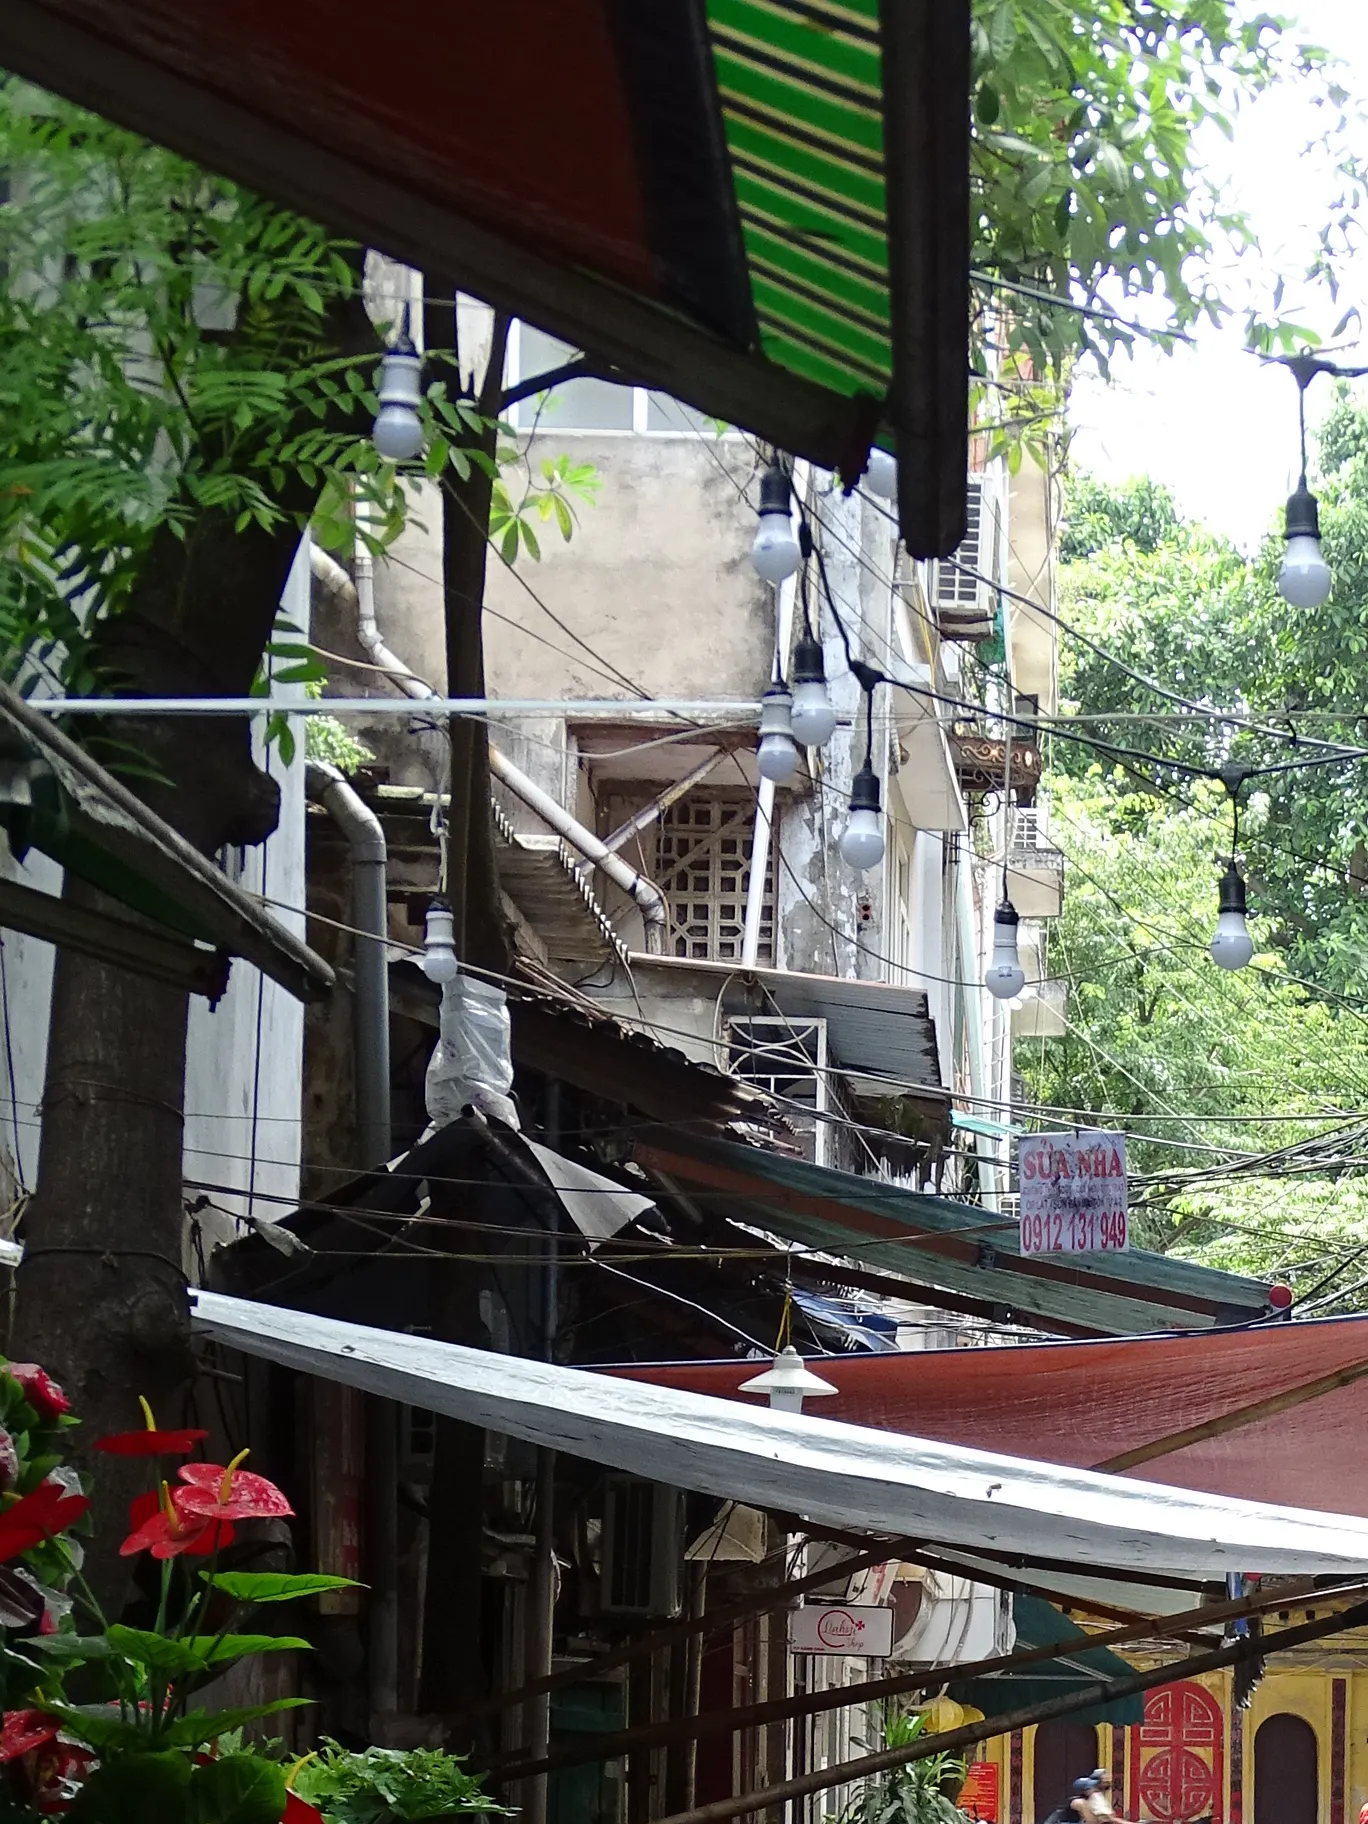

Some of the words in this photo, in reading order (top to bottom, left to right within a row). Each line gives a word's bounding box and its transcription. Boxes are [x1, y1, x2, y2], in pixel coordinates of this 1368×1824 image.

[1022, 1213, 1063, 1252] 0912
[1068, 1211, 1095, 1250] 131
[1100, 1210, 1126, 1250] 949
